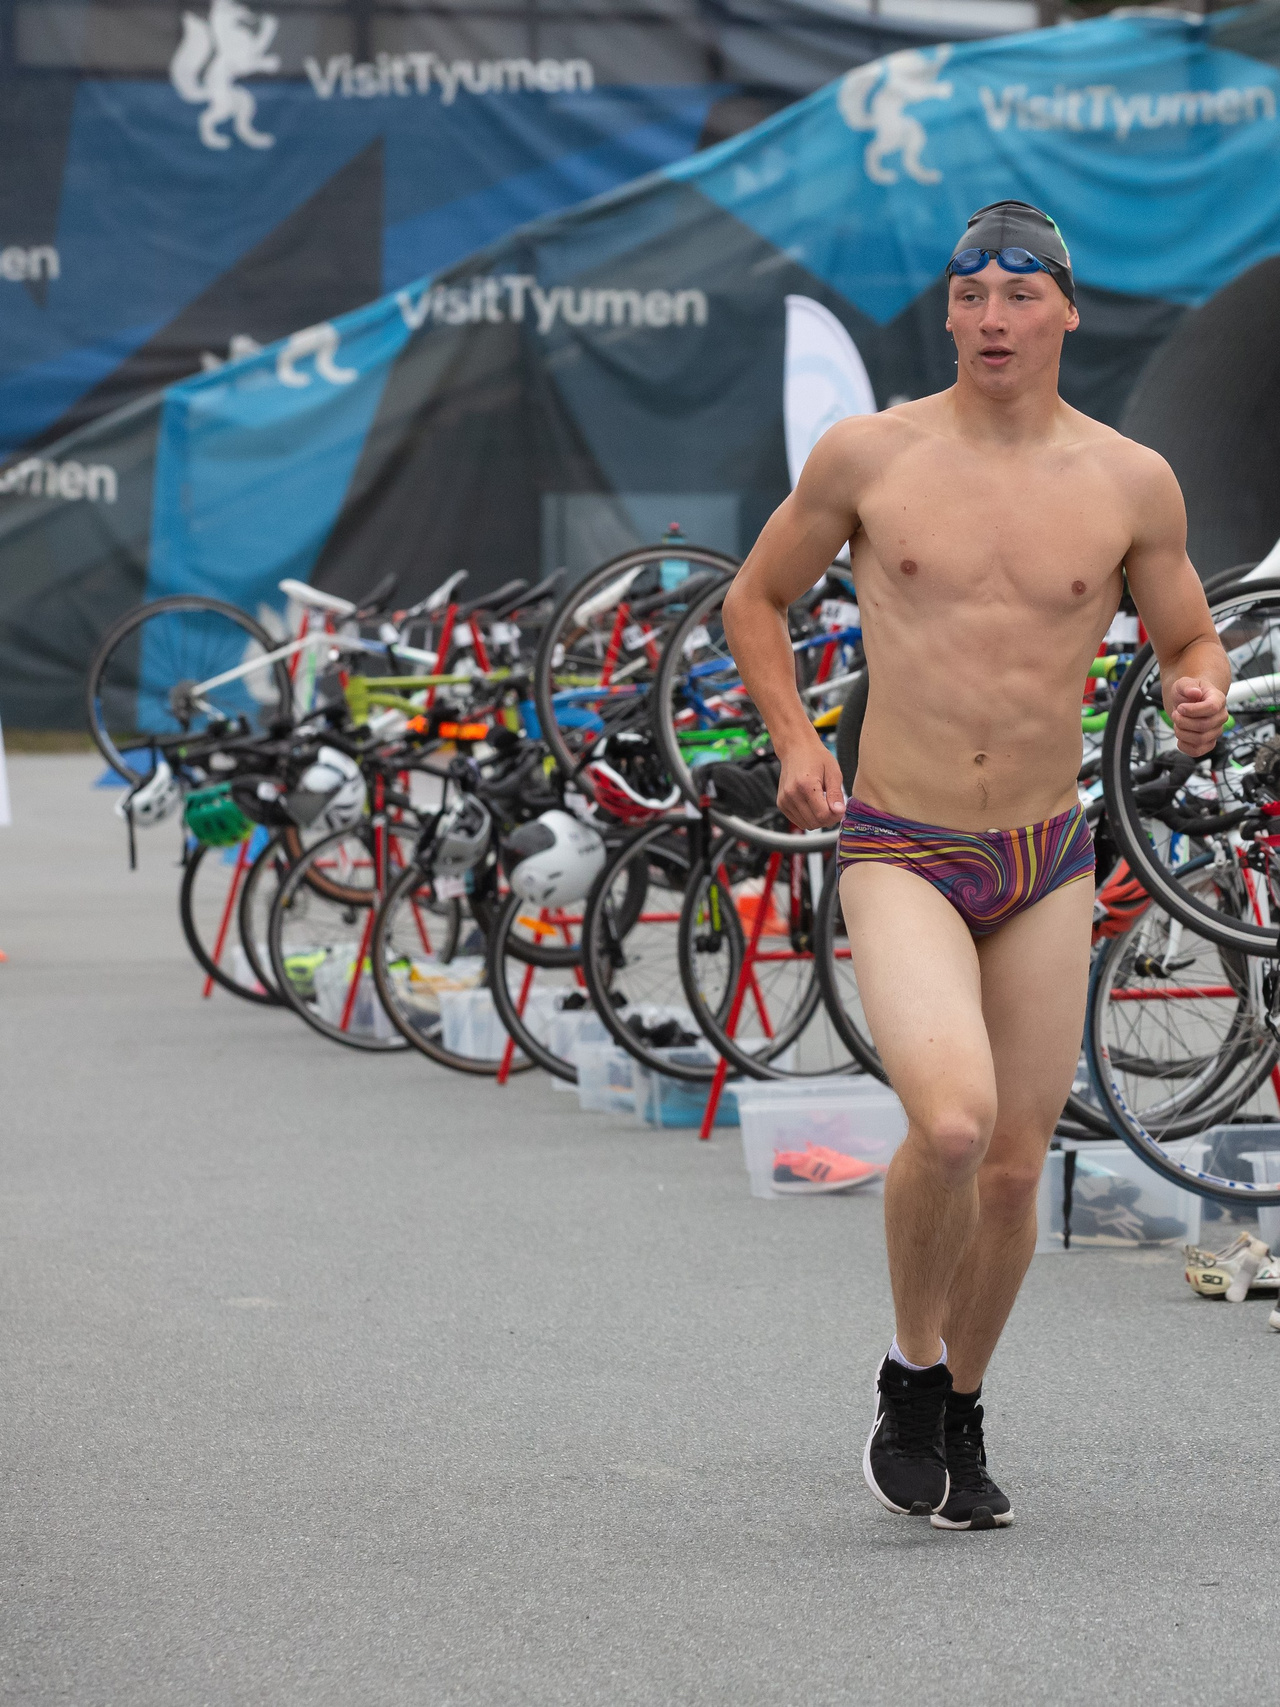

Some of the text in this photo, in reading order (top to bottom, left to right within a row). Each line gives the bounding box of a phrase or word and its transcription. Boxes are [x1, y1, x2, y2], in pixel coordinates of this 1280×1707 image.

[306, 53, 594, 105] VisitTyumen
[978, 84, 1279, 140] VisitTyumen
[0, 244, 60, 281] en
[398, 274, 709, 333] VisitTyumen
